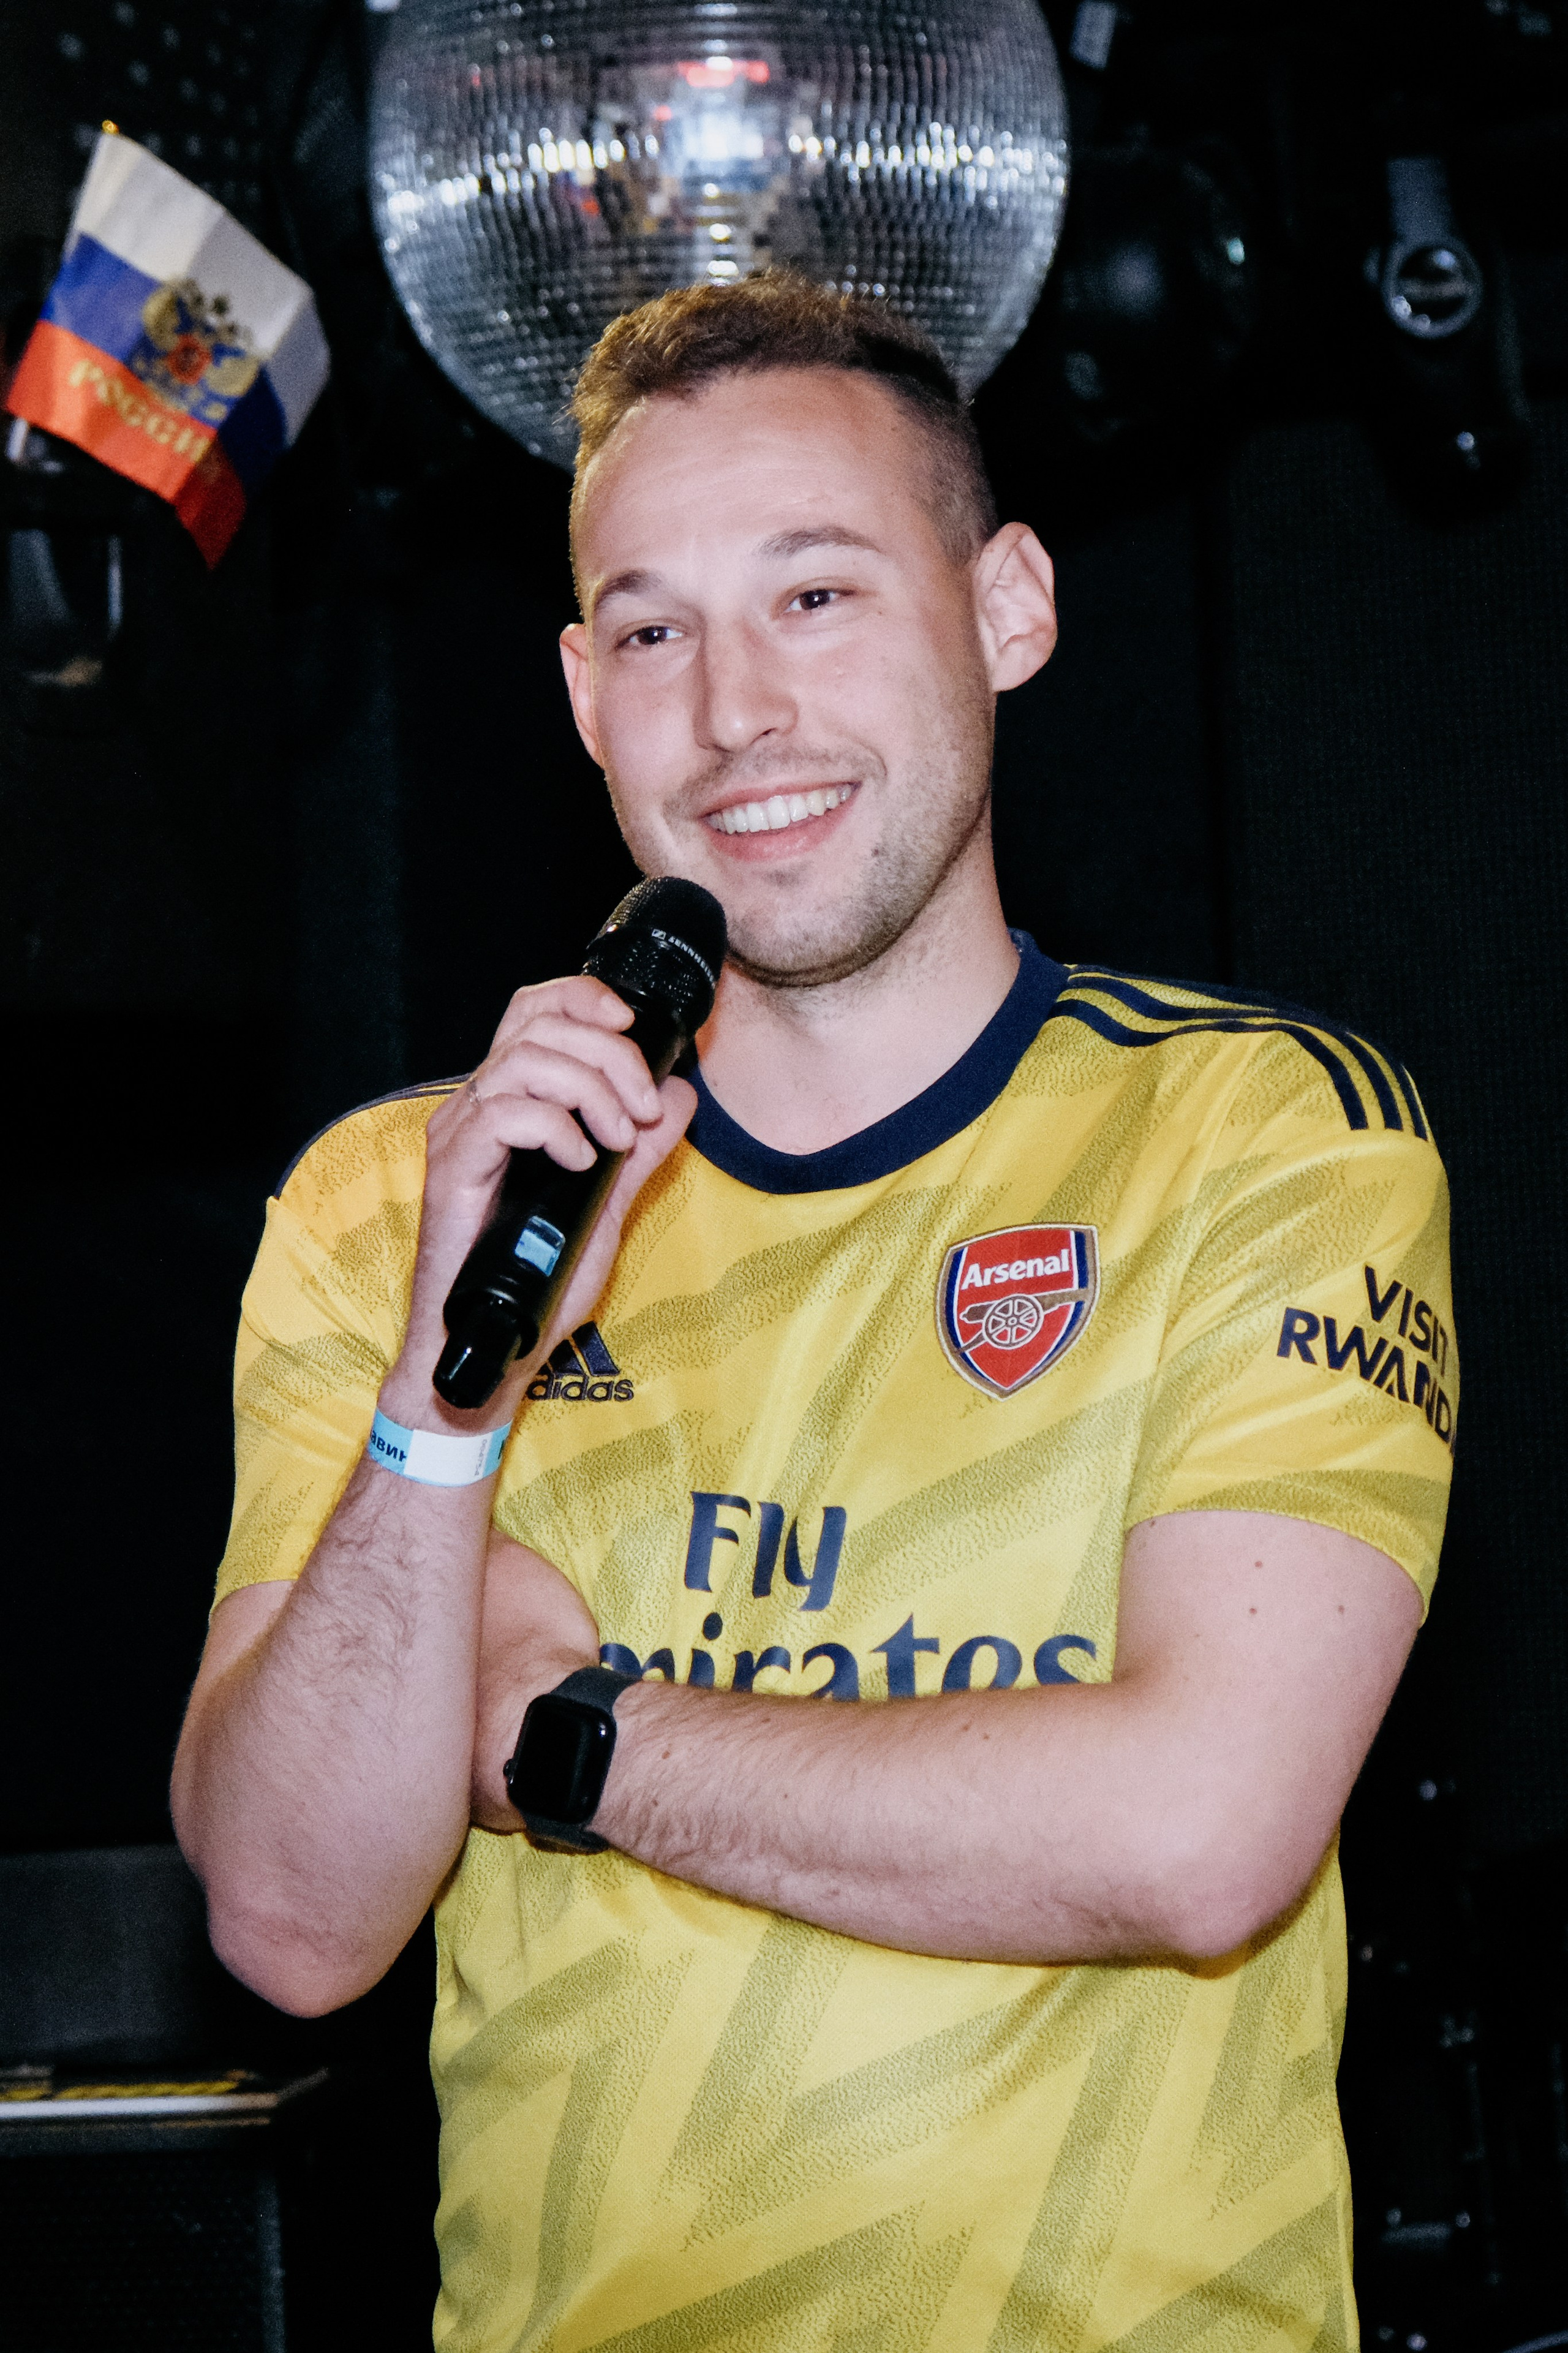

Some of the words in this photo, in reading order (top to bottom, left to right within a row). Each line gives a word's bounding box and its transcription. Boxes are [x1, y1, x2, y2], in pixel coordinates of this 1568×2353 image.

[961, 1249, 1070, 1290] Arsenal
[527, 1373, 634, 1402] didas
[1277, 1307, 1455, 1457] RWAND
[684, 1490, 846, 1612] Fly
